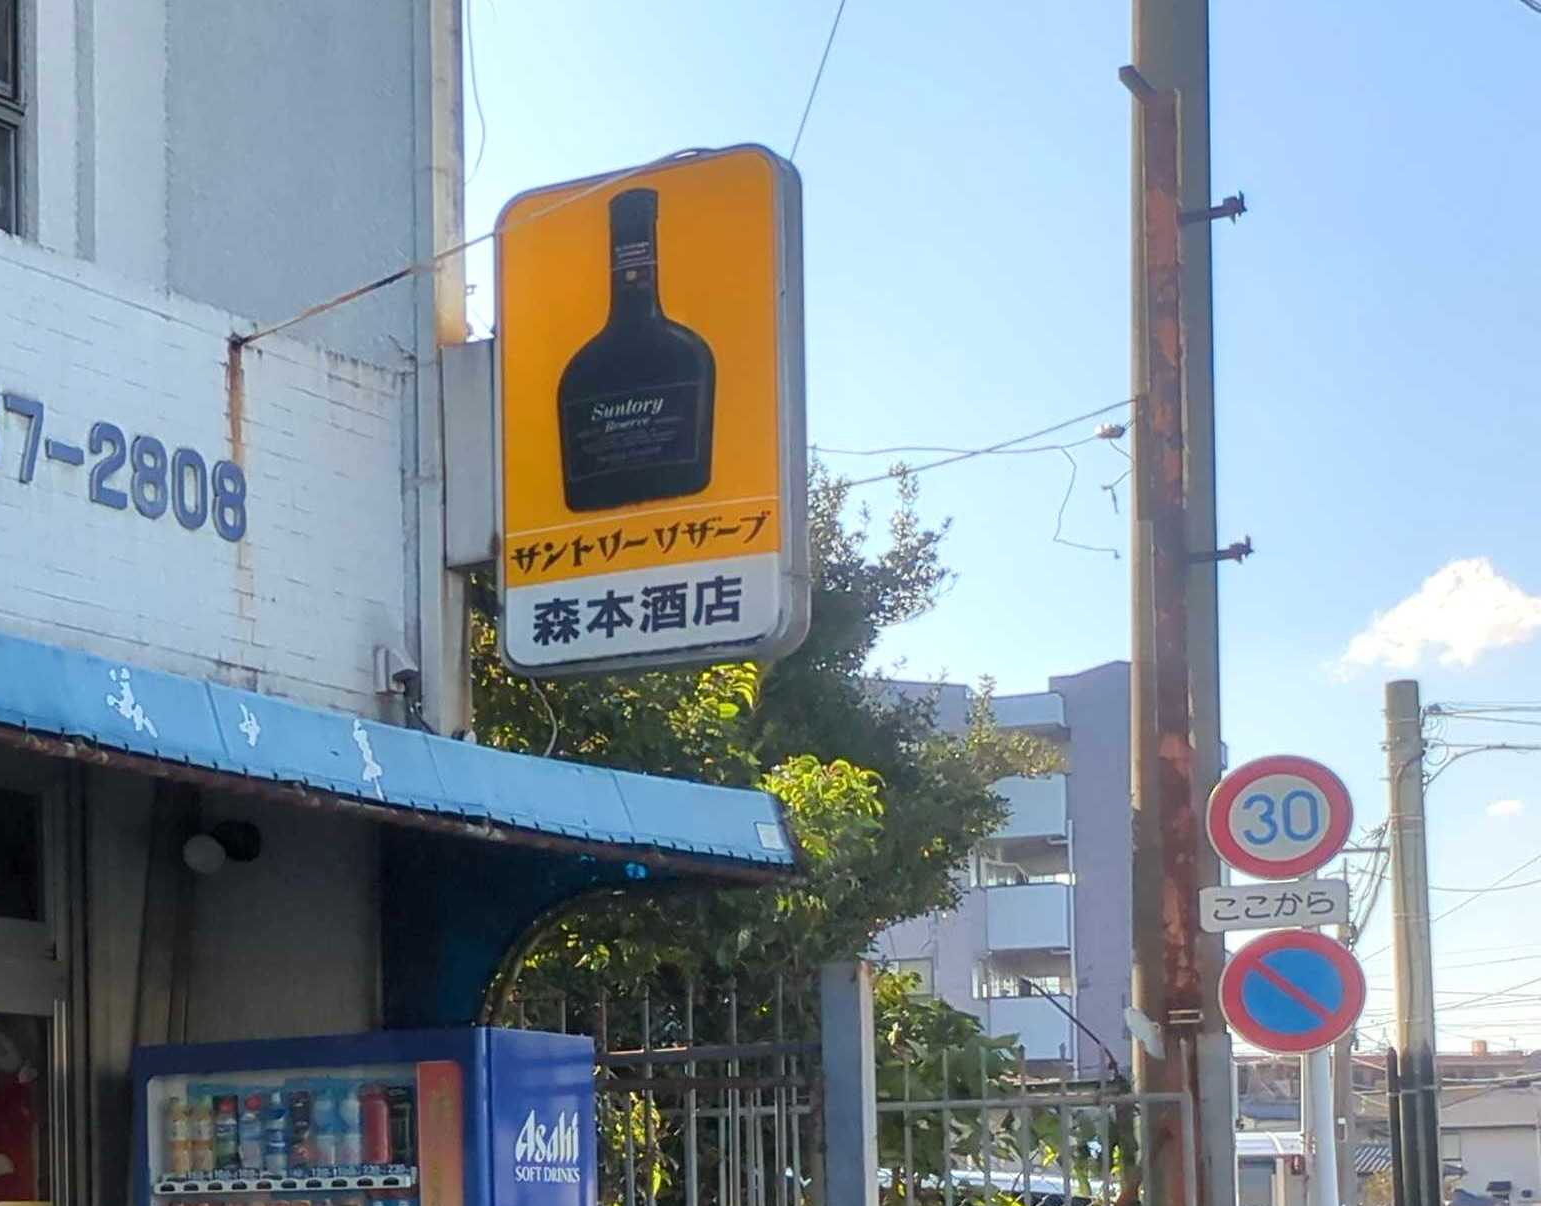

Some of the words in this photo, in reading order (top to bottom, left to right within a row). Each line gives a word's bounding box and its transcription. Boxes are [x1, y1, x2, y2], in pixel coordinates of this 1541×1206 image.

[532, 575, 742, 646] 森本酒店
[1242, 789, 1320, 846] 30
[1213, 891, 1335, 922] ここから
[515, 1109, 579, 1164] Asahi
[515, 1165, 542, 1183] SOFT
[543, 1166, 581, 1184] DRINKS
